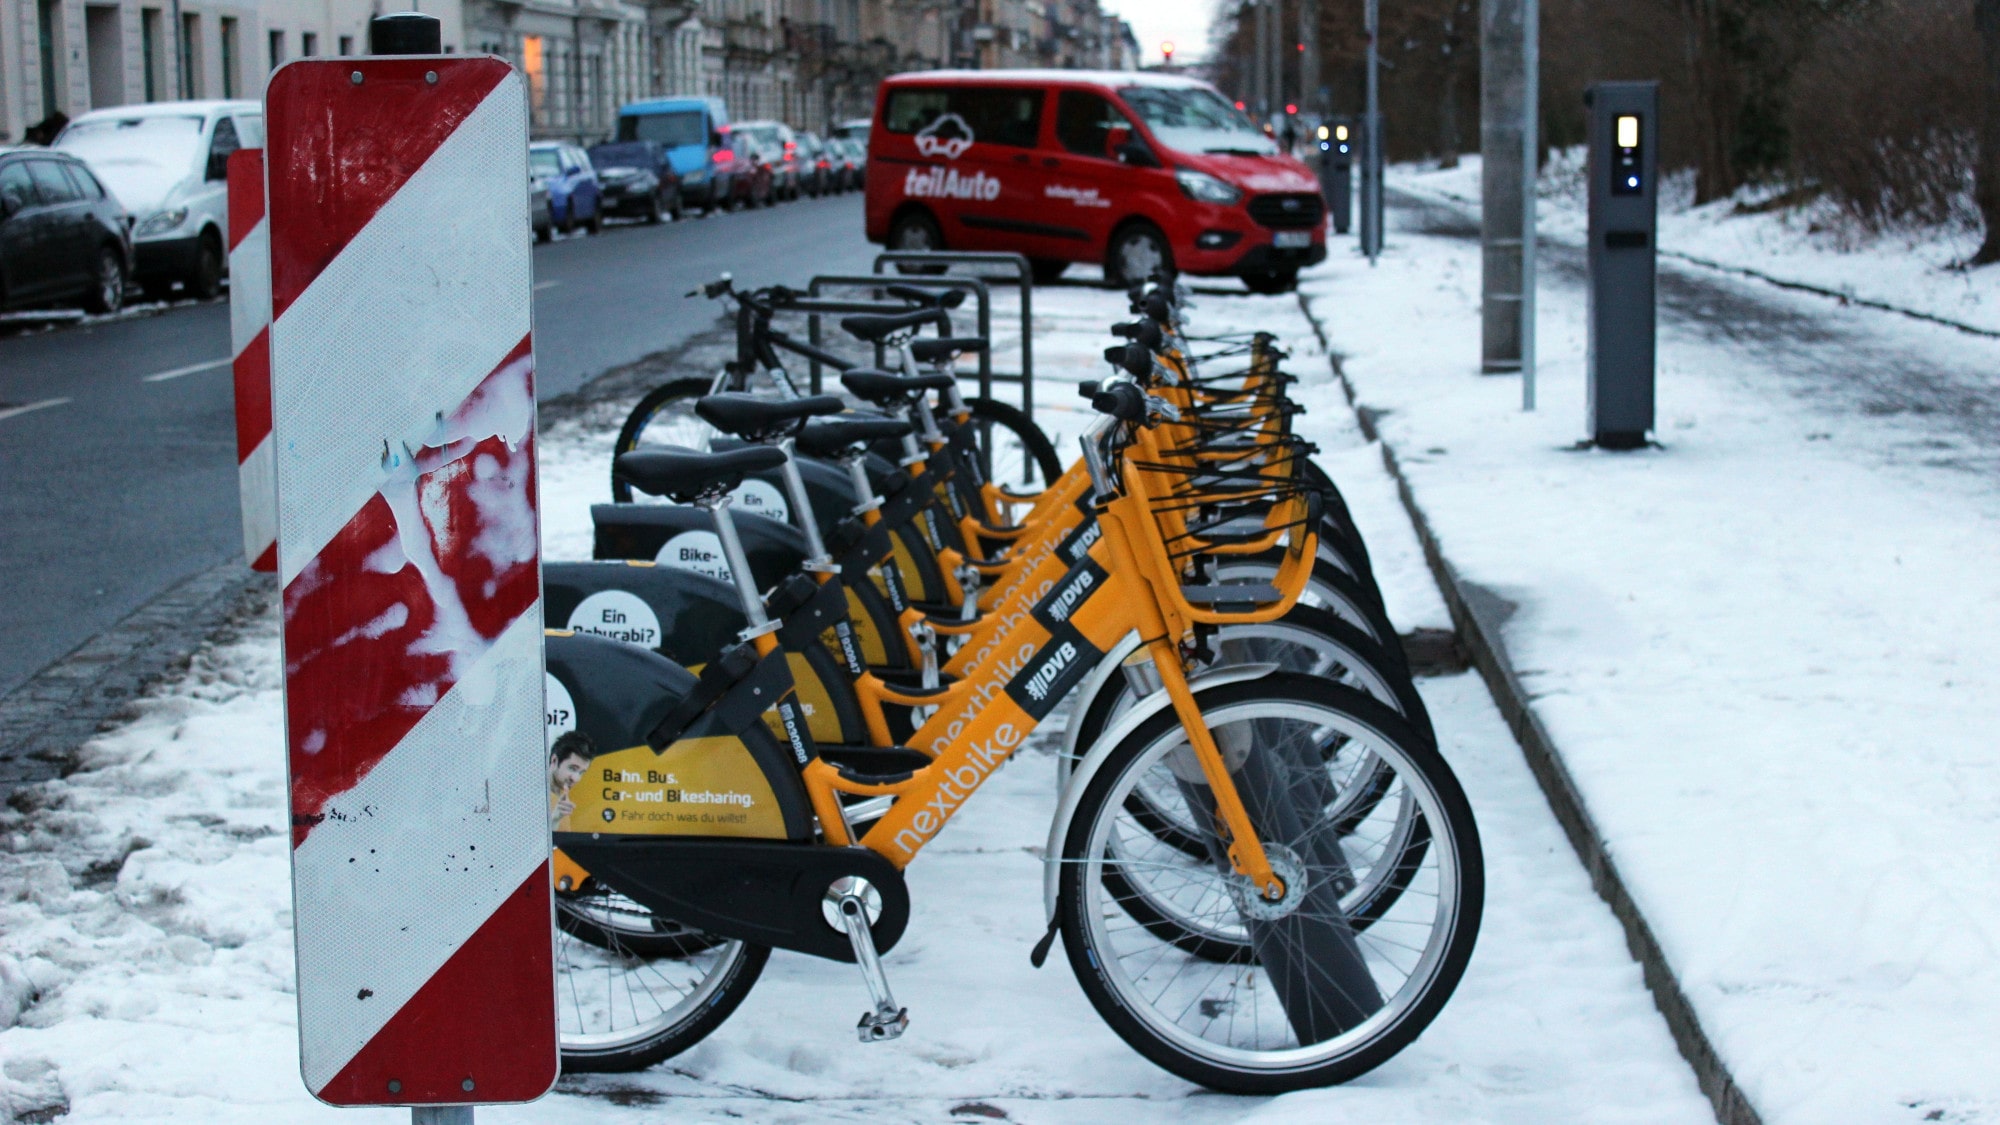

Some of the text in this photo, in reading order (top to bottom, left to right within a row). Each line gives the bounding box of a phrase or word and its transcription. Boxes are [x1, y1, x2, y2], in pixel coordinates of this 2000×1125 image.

[904, 165, 1000, 201] teilAuto
[744, 494, 763, 505] Ein
[680, 548, 718, 561] Bike-
[1061, 570, 1094, 606] DVB
[602, 609, 626, 624] Ein
[573, 625, 655, 643] ucabi?
[1040, 641, 1077, 682] DVB
[931, 643, 1035, 755] nextbike
[785, 721, 808, 764] 930888
[603, 769, 678, 784] Bahn. Bus.
[602, 788, 755, 808] Car- und Bikesharing.
[893, 723, 1020, 854] nextbike
[621, 810, 645, 821] Fahr
[648, 811, 674, 822] doch
[677, 813, 698, 822] was
[701, 812, 714, 823] du
